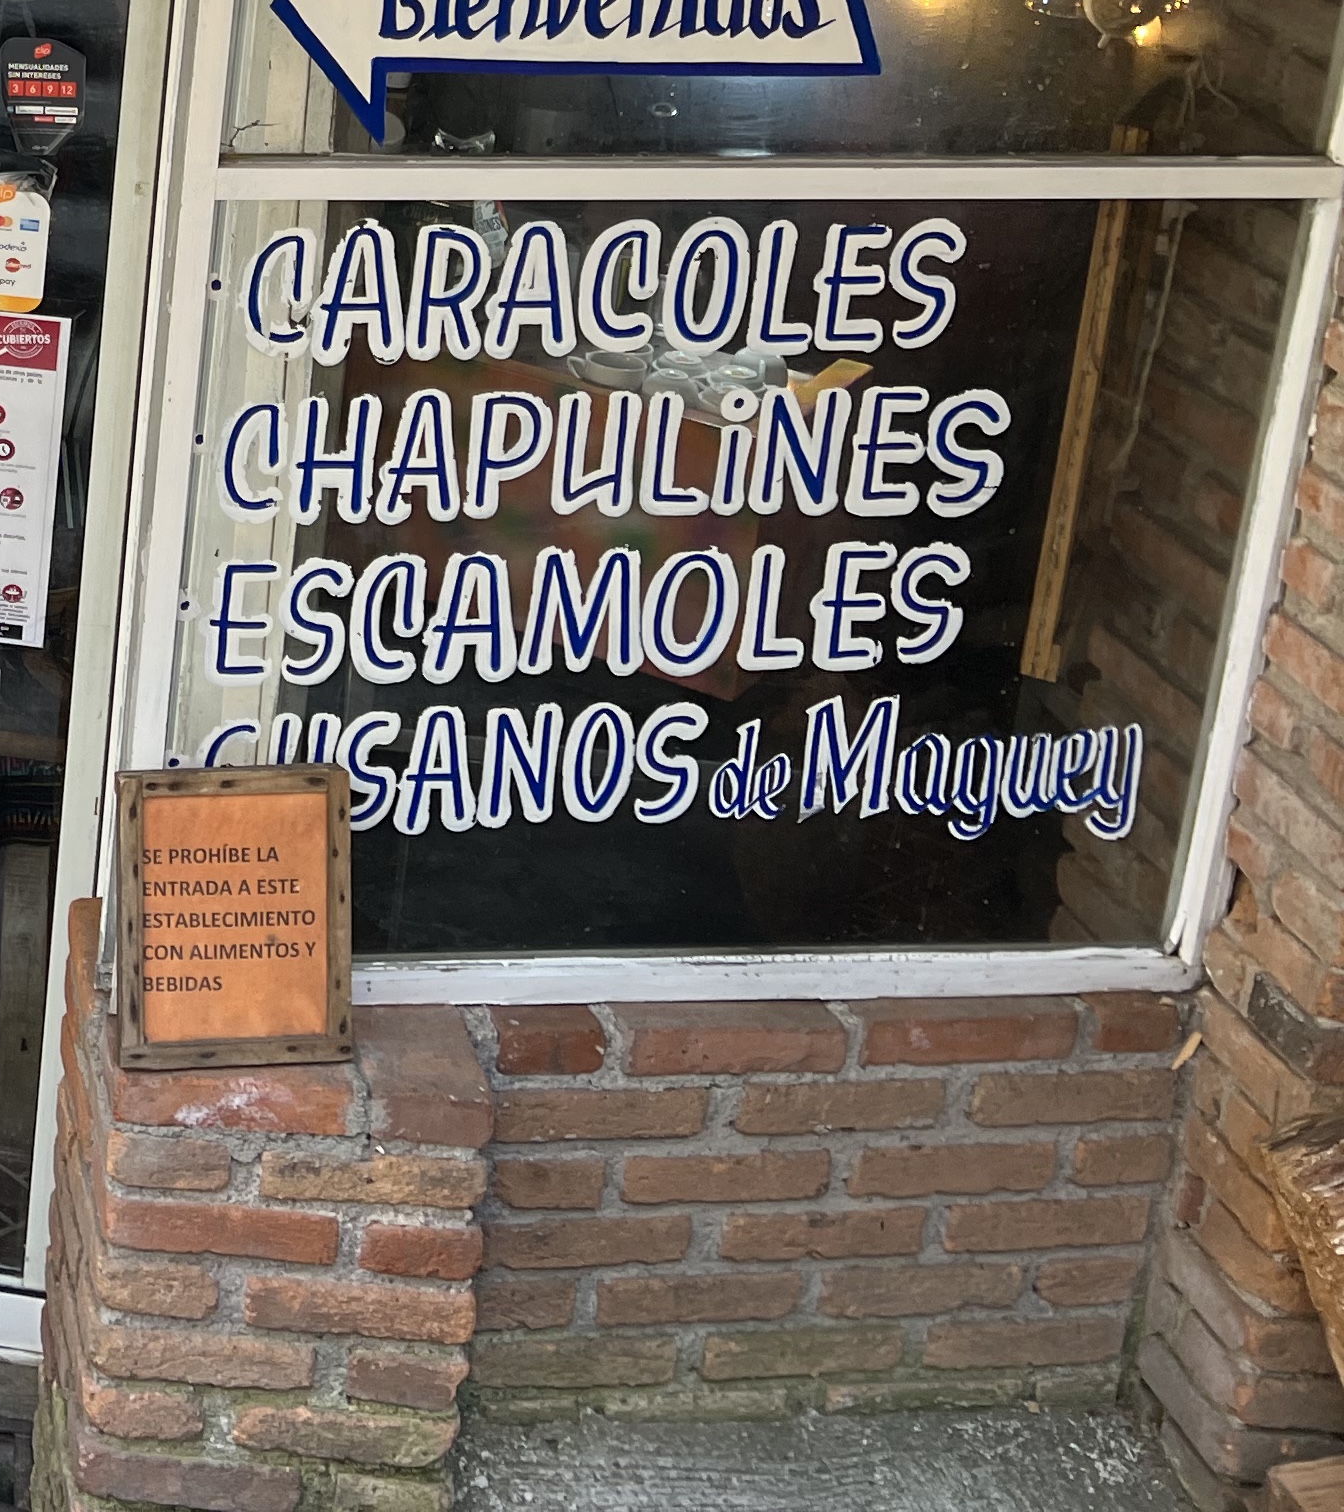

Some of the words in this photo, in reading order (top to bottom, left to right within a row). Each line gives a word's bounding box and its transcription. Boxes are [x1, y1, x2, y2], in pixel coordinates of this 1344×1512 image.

[8, 63, 69, 71] MENSUALIDADES
[8, 71, 20, 79] SIN
[21, 72, 61, 80] INTERESES
[12, 84, 18, 93] 3
[29, 85, 36, 94] 6
[47, 85, 53, 94] 9
[61, 85, 72, 95] 12
[0, 278, 16, 286] pay
[246, 217, 967, 366] CARACOLES
[204, 541, 973, 684] ESCAMOLES
[713, 720, 789, 824] de
[799, 694, 1144, 841] Maguey
[142, 848, 162, 865] SE
[168, 843, 251, 864] PROHÍBE
[257, 846, 279, 863] LA
[143, 880, 232, 897] ENTRADA
[238, 879, 251, 895] A
[257, 878, 300, 895] ESTE
[143, 909, 316, 929] ESTABLECIMIENTO
[143, 943, 184, 961] CON
[189, 941, 300, 960] ALIMENTOS
[305, 941, 316, 958] Y
[143, 975, 223, 992] BEBIDAS
